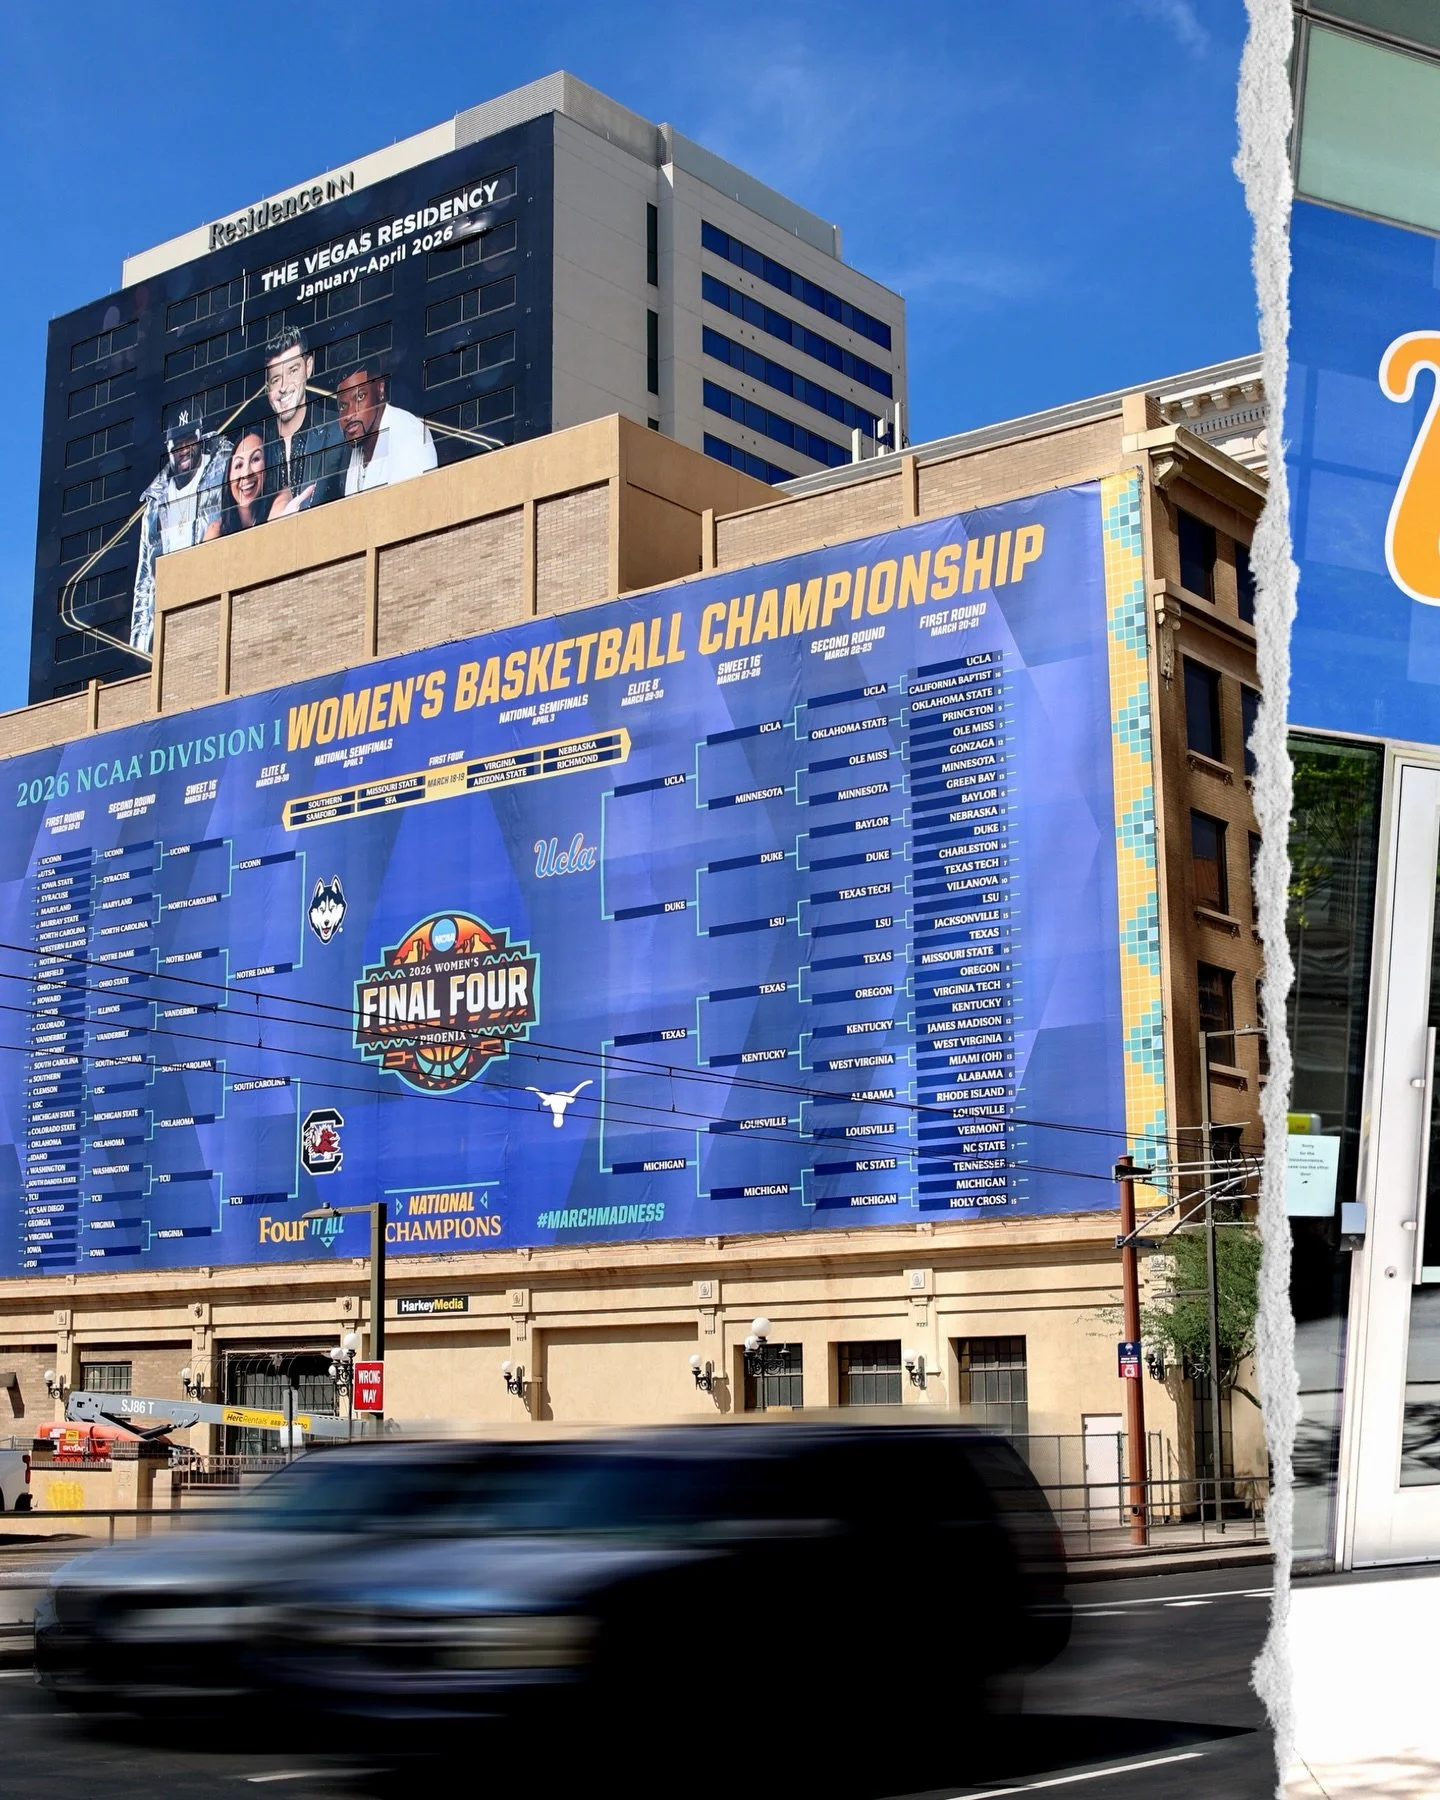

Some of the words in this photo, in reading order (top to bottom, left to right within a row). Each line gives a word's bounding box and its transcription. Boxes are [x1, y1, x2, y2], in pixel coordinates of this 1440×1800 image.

[208, 182, 323, 250] Residence
[326, 171, 354, 200] INN
[261, 261, 299, 291] THE
[304, 233, 373, 274] VEGAS
[378, 180, 499, 244] RESIDENCY
[412, 225, 454, 256] 2026
[919, 610, 949, 629] FIRST
[951, 602, 987, 623] ROUND
[930, 622, 957, 637] MARCH
[958, 617, 979, 630] 20-21
[811, 635, 849, 655] SECOND
[851, 626, 885, 645] ROUND
[824, 647, 849, 661] MARCH
[966, 653, 992, 666] UCLA
[17, 772, 69, 807] 2026
[77, 755, 143, 793] NCAA
[150, 722, 264, 775] DIVISION
[274, 719, 281, 746] I
[286, 668, 446, 753] WOMEN'S
[453, 608, 686, 714] BASKETBALL
[697, 522, 1045, 657] CHAMPIONSHIP
[718, 657, 748, 675] SWEET
[749, 655, 760, 669] 16
[717, 672, 740, 685] MARCH
[909, 678, 957, 695] CALIFORNIA
[959, 670, 992, 684] BAPTIST
[628, 680, 651, 696] ELITE
[651, 679, 659, 692] 8
[864, 685, 886, 696] UCLA
[621, 694, 644, 706] MARCH
[912, 694, 965, 711] OKLAHOMA
[966, 687, 993, 700] STATE
[499, 706, 537, 724] NATIONAL
[539, 694, 588, 715] SEMIFINALS
[942, 704, 993, 722] PRINCETON
[532, 715, 549, 726] APRIL
[550, 714, 555, 722] 3
[760, 721, 781, 733] UCLA
[812, 723, 861, 739] OKLAHOMA
[862, 717, 887, 729] STATE
[953, 725, 972, 736] OLE
[973, 721, 995, 732] MISS
[314, 749, 348, 766] NATIONAL
[349, 739, 393, 758] SEMIFINALS
[558, 741, 597, 756] NEBRASKA
[950, 738, 995, 754] GONZAGA
[429, 754, 447, 766] FIRST
[447, 751, 464, 762] FOUR
[484, 758, 516, 770] VIRGINIA
[557, 754, 598, 769] RICHMOND
[849, 754, 866, 765] OLE
[867, 750, 888, 761] MISS
[942, 755, 995, 773] MINNESOTA
[427, 776, 449, 788] MARCH
[450, 772, 465, 783] 18-19
[473, 773, 505, 786] ARIZONA
[506, 768, 527, 779] STATE
[664, 775, 684, 786] UCLA
[946, 776, 976, 789] GREEN
[978, 772, 996, 783] BAY
[366, 782, 398, 796] MISSOURI
[398, 779, 418, 790] STATE
[735, 787, 783, 803] MINNESOTA
[838, 783, 888, 800] MINNESOTA
[308, 795, 343, 809] SOUTHERN
[384, 797, 397, 805] SFA
[961, 789, 997, 803] BAYLOR
[306, 809, 337, 822] SAMFORD
[950, 806, 998, 822] NEBRASKA
[855, 816, 889, 830] BAYLOR
[974, 823, 999, 835] DUKE
[170, 845, 190, 855] UCONN
[761, 851, 783, 863] DUKE
[866, 851, 890, 862] DUKE
[939, 841, 998, 859] CHARLESTON
[240, 859, 261, 869] UCONN
[944, 862, 973, 874] TEXAS
[974, 858, 999, 870] TECH
[947, 876, 999, 891] VILLANOVA
[839, 887, 866, 900] TEXAS
[867, 884, 890, 894] TECH
[982, 893, 1000, 903] LSU
[168, 900, 188, 910] NORTH
[188, 895, 217, 907] CAROLINA
[664, 900, 685, 912] DUKE
[769, 917, 785, 927] LSU
[875, 918, 891, 928] LSU
[935, 910, 1000, 929] JACKSONVILLE
[969, 928, 1000, 940] TEXAS
[864, 952, 892, 964] TEXAS
[922, 949, 965, 964] MISSOURI
[966, 945, 994, 957] STATE
[236, 968, 257, 980] NOTRE
[257, 966, 275, 975] DAME
[409, 965, 432, 977] 2026
[434, 957, 479, 973] WOMEN'S
[960, 963, 1000, 976] OREGON
[759, 983, 785, 994] TEXAS
[855, 986, 892, 999] OREGON
[933, 983, 975, 997] VIRGINIA
[976, 980, 1001, 991] TECH
[363, 979, 441, 1028] FINAL
[449, 966, 528, 1017] FOUR
[952, 998, 1001, 1012] KENTUCKY
[847, 1020, 893, 1034] KENTUCKY
[928, 1021, 956, 1034] JAMES
[957, 1016, 1002, 1029] MADISON
[420, 1030, 467, 1045] PHOENIX
[661, 1030, 685, 1039] TEXAS
[933, 1037, 959, 1049] WEST
[960, 1034, 1002, 1046] VIRGINIA
[742, 1049, 786, 1063] KENTUCKY
[829, 1059, 853, 1070] WEST
[854, 1055, 894, 1067] VIRGINIA
[949, 1054, 980, 1066] MIAMI
[981, 1051, 1002, 1063] (OH)
[957, 1069, 1003, 1082] ALABAMA
[937, 1091, 968, 1102] RHODE
[970, 1087, 1005, 1098] ISLAND
[846, 1124, 895, 1137] LOUISVILLE
[958, 1123, 1005, 1135] VERMONT
[963, 1143, 977, 1153] NC
[978, 1141, 1006, 1151] STATE
[643, 1160, 684, 1171] MICHIGAN
[856, 1161, 869, 1172] NC
[870, 1159, 896, 1170] STATE
[956, 1177, 1006, 1189] MICHIGAN
[744, 1185, 788, 1197] MICHIGAN
[409, 1192, 474, 1215] NATIONAL
[851, 1194, 897, 1206] MICHIGAN
[950, 1197, 975, 1208] HOLY
[976, 1195, 1007, 1206] CROSS
[537, 1202, 665, 1229] #MARCHMADNESS
[259, 1216, 309, 1243] Four
[324, 1216, 344, 1234] ALL
[385, 1215, 501, 1242] CHAMPIONS
[402, 1298, 463, 1312] HarkeyMedia
[358, 1370, 381, 1385] WRONG
[362, 1389, 377, 1403] WAY
[121, 1399, 146, 1414] SJ86
[148, 1402, 155, 1415] T
